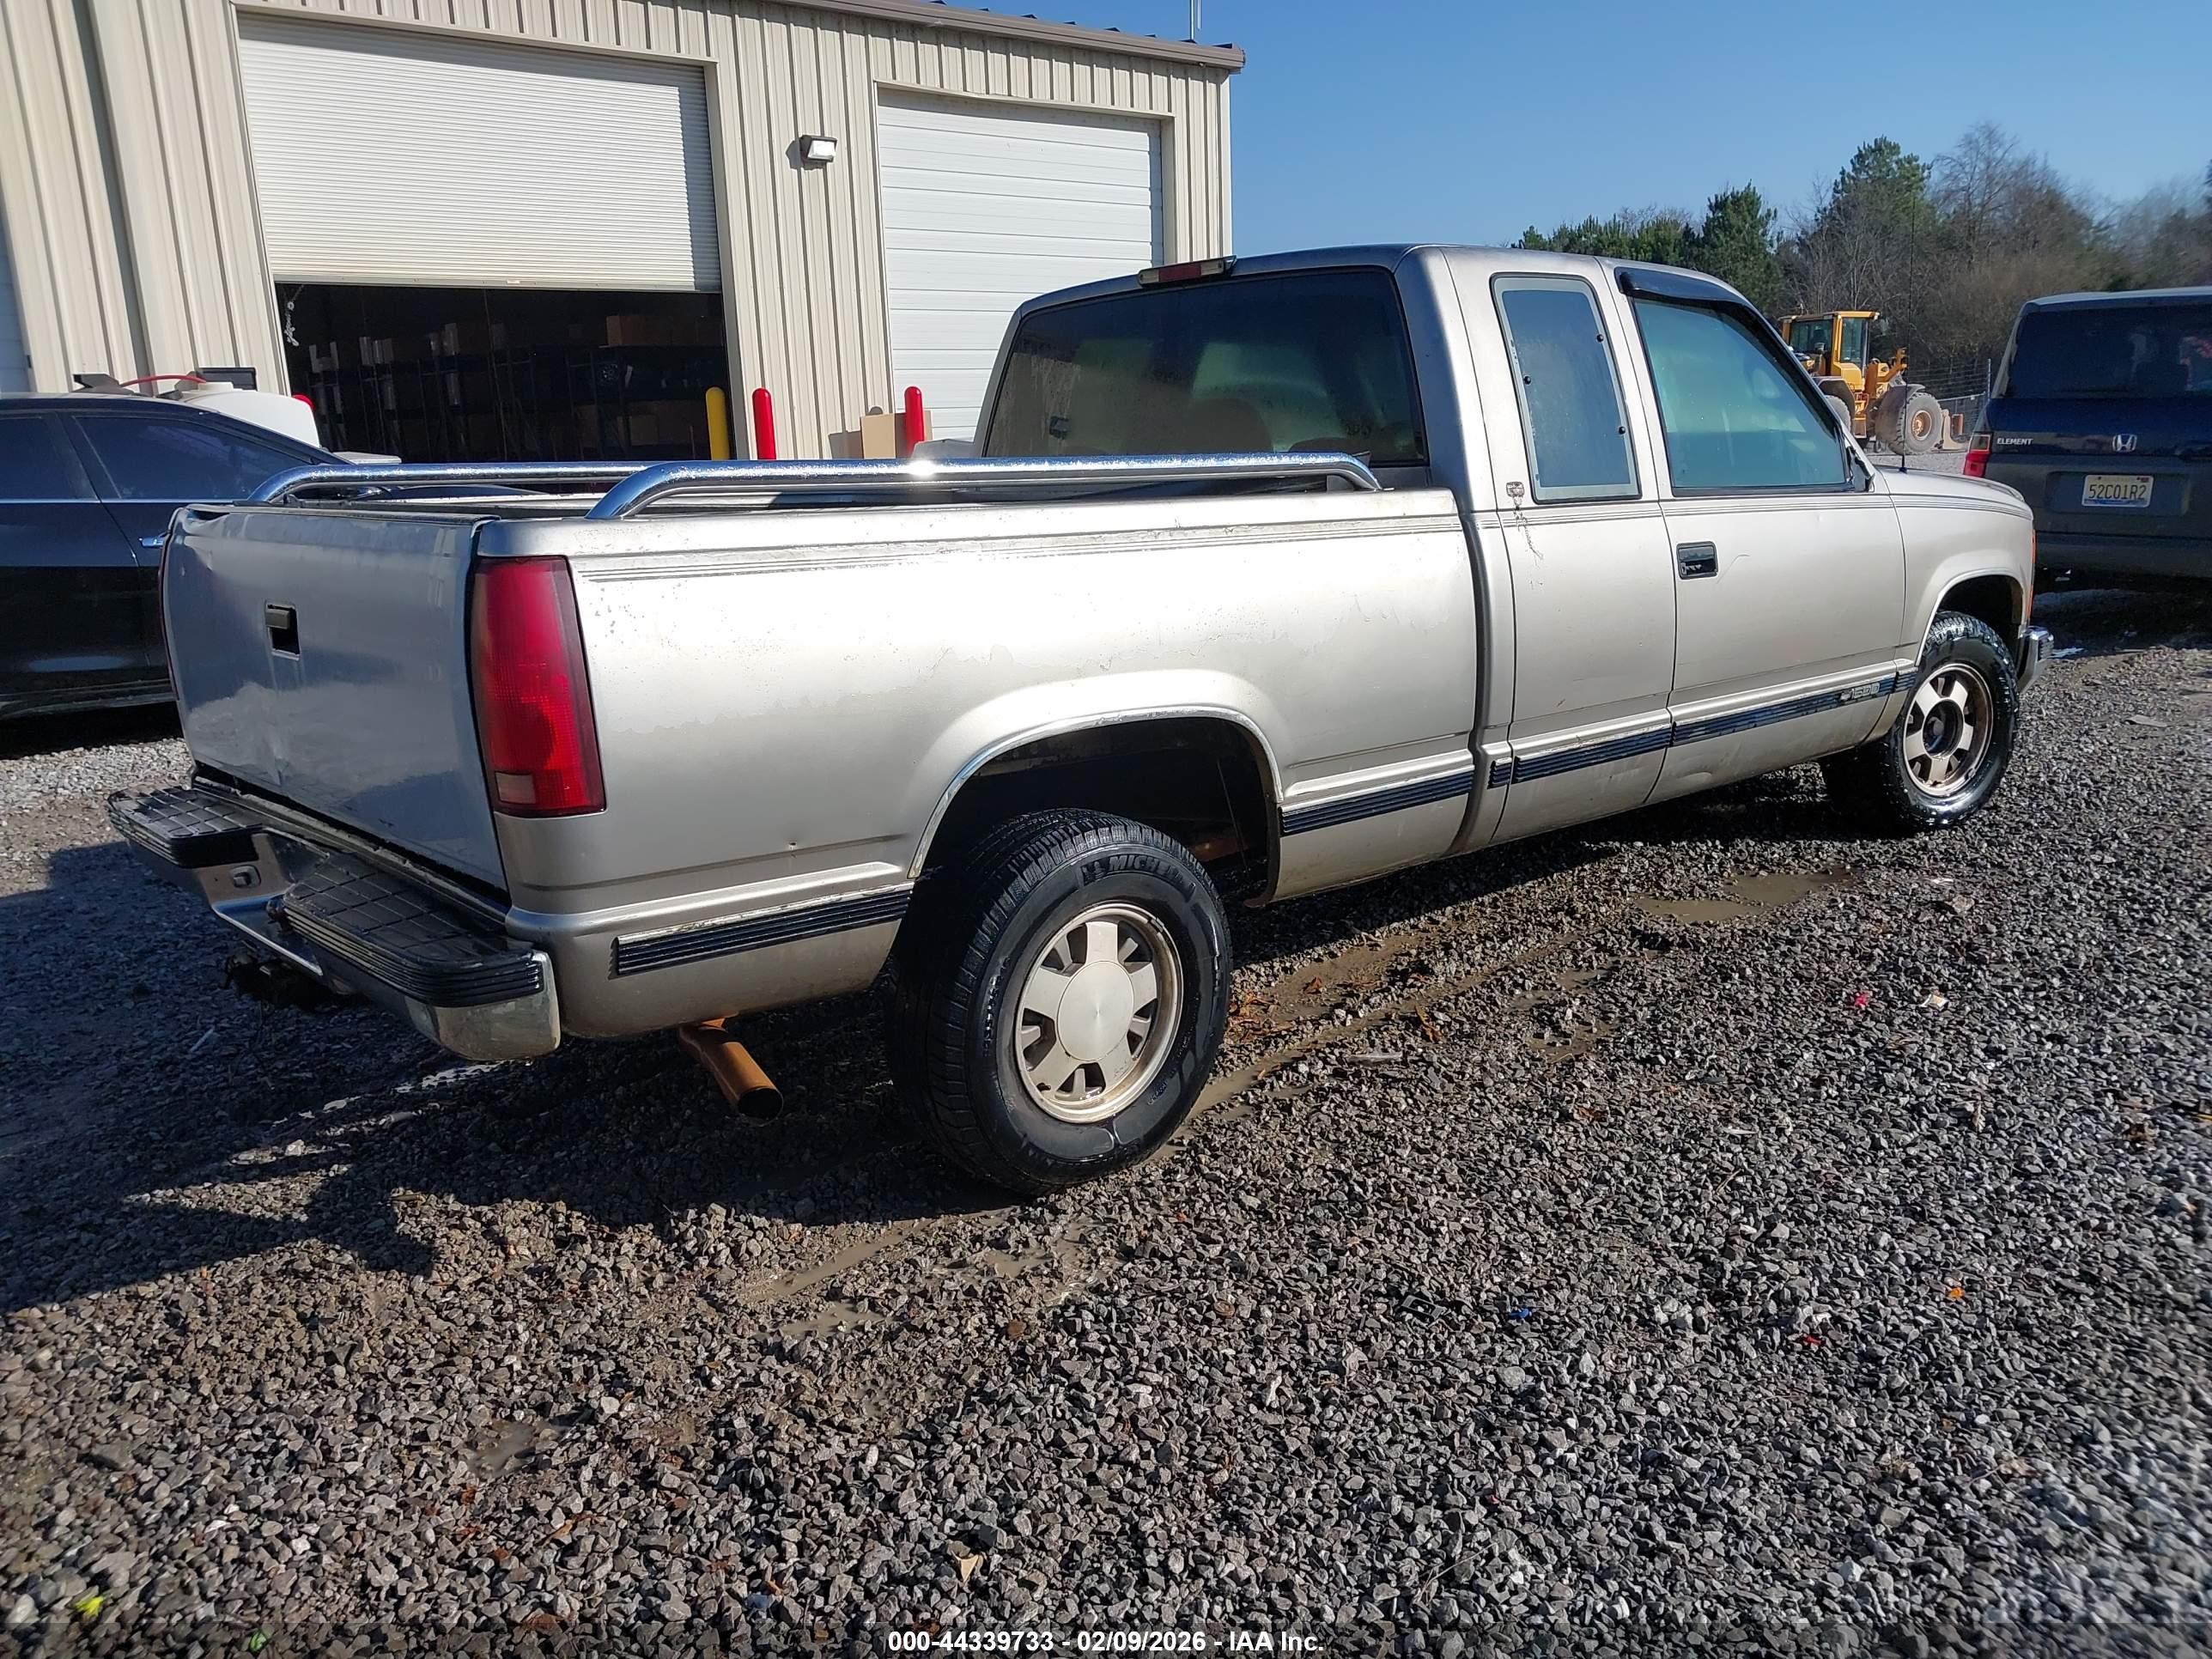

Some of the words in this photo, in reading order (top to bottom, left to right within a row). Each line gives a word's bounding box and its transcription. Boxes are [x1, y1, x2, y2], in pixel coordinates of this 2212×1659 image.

[1996, 437, 2033, 446] ELEMENT
[2087, 483, 2147, 500] 52C01R2
[1108, 854, 1185, 885] MICHE
